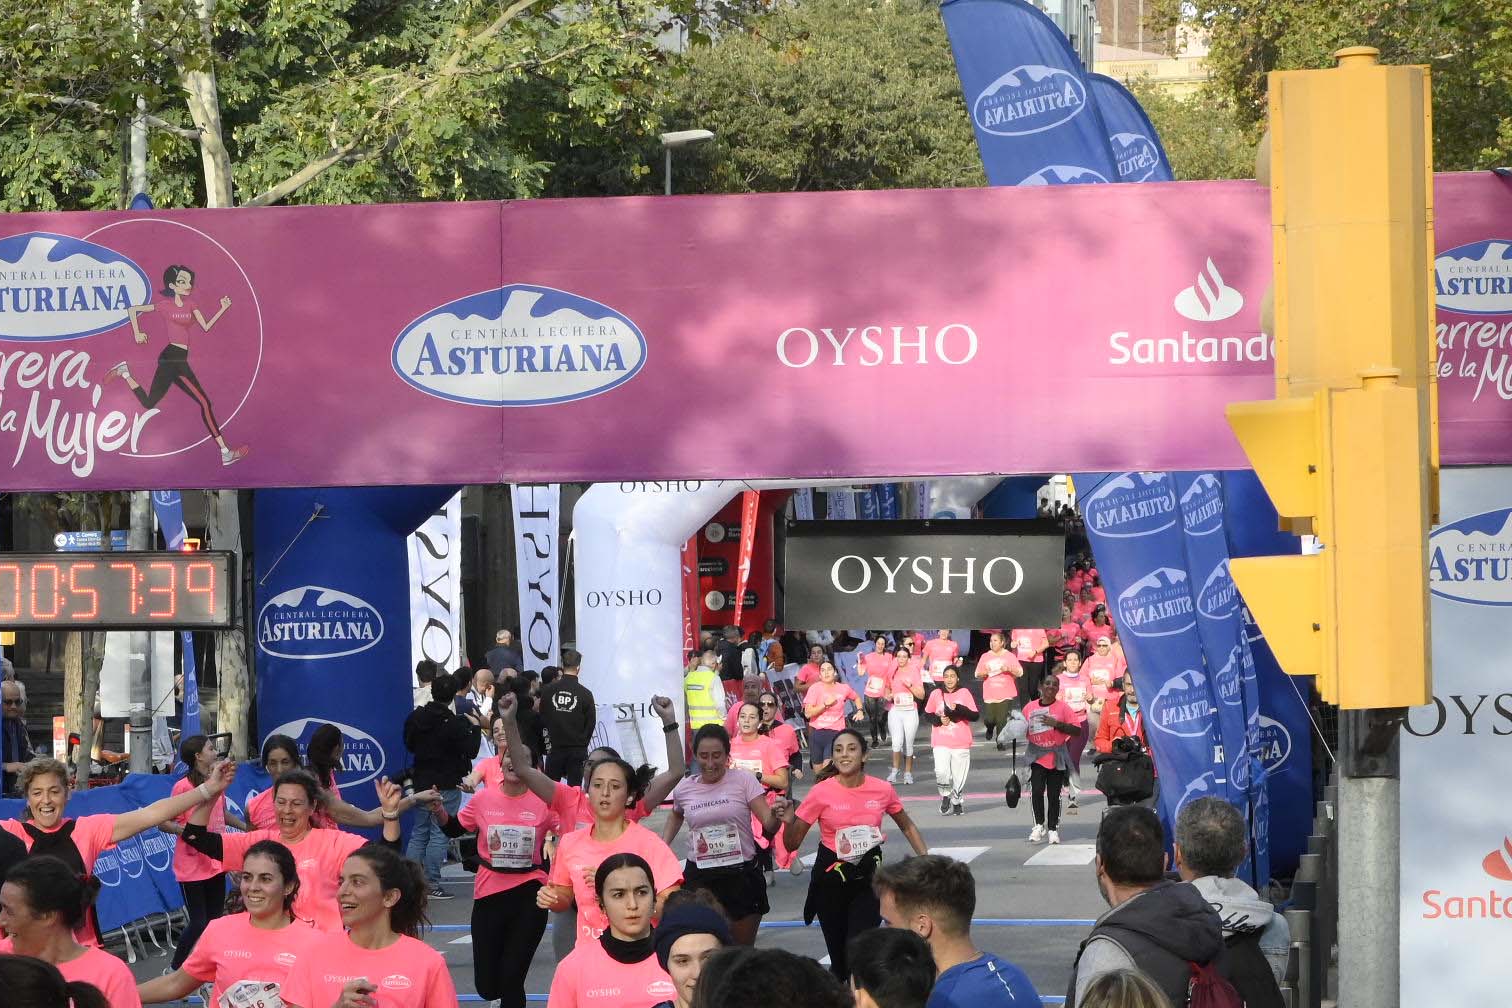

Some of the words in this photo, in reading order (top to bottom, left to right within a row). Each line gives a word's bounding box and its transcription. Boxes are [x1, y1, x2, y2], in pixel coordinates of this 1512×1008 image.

[53, 267, 128, 281] LECHERA
[1449, 265, 1502, 275] CENTRAL
[450, 327, 530, 341] CENTRAL
[537, 324, 618, 339] LECHERA
[410, 332, 628, 376] ASTURIANA
[776, 323, 979, 368] OYSHO
[1459, 350, 1477, 378] la
[12, 383, 161, 479] Mujer
[1457, 543, 1512, 553] CENTRA
[830, 554, 1024, 596] OYSHO
[586, 588, 663, 609] OYSHO
[274, 610, 318, 621] CENTRAL
[320, 609, 371, 620] LECHERA
[261, 617, 375, 643] ASTURIANA
[1401, 693, 1512, 737] OYS
[690, 798, 730, 811] CUATRECASAS
[586, 987, 622, 998] OYSHO
